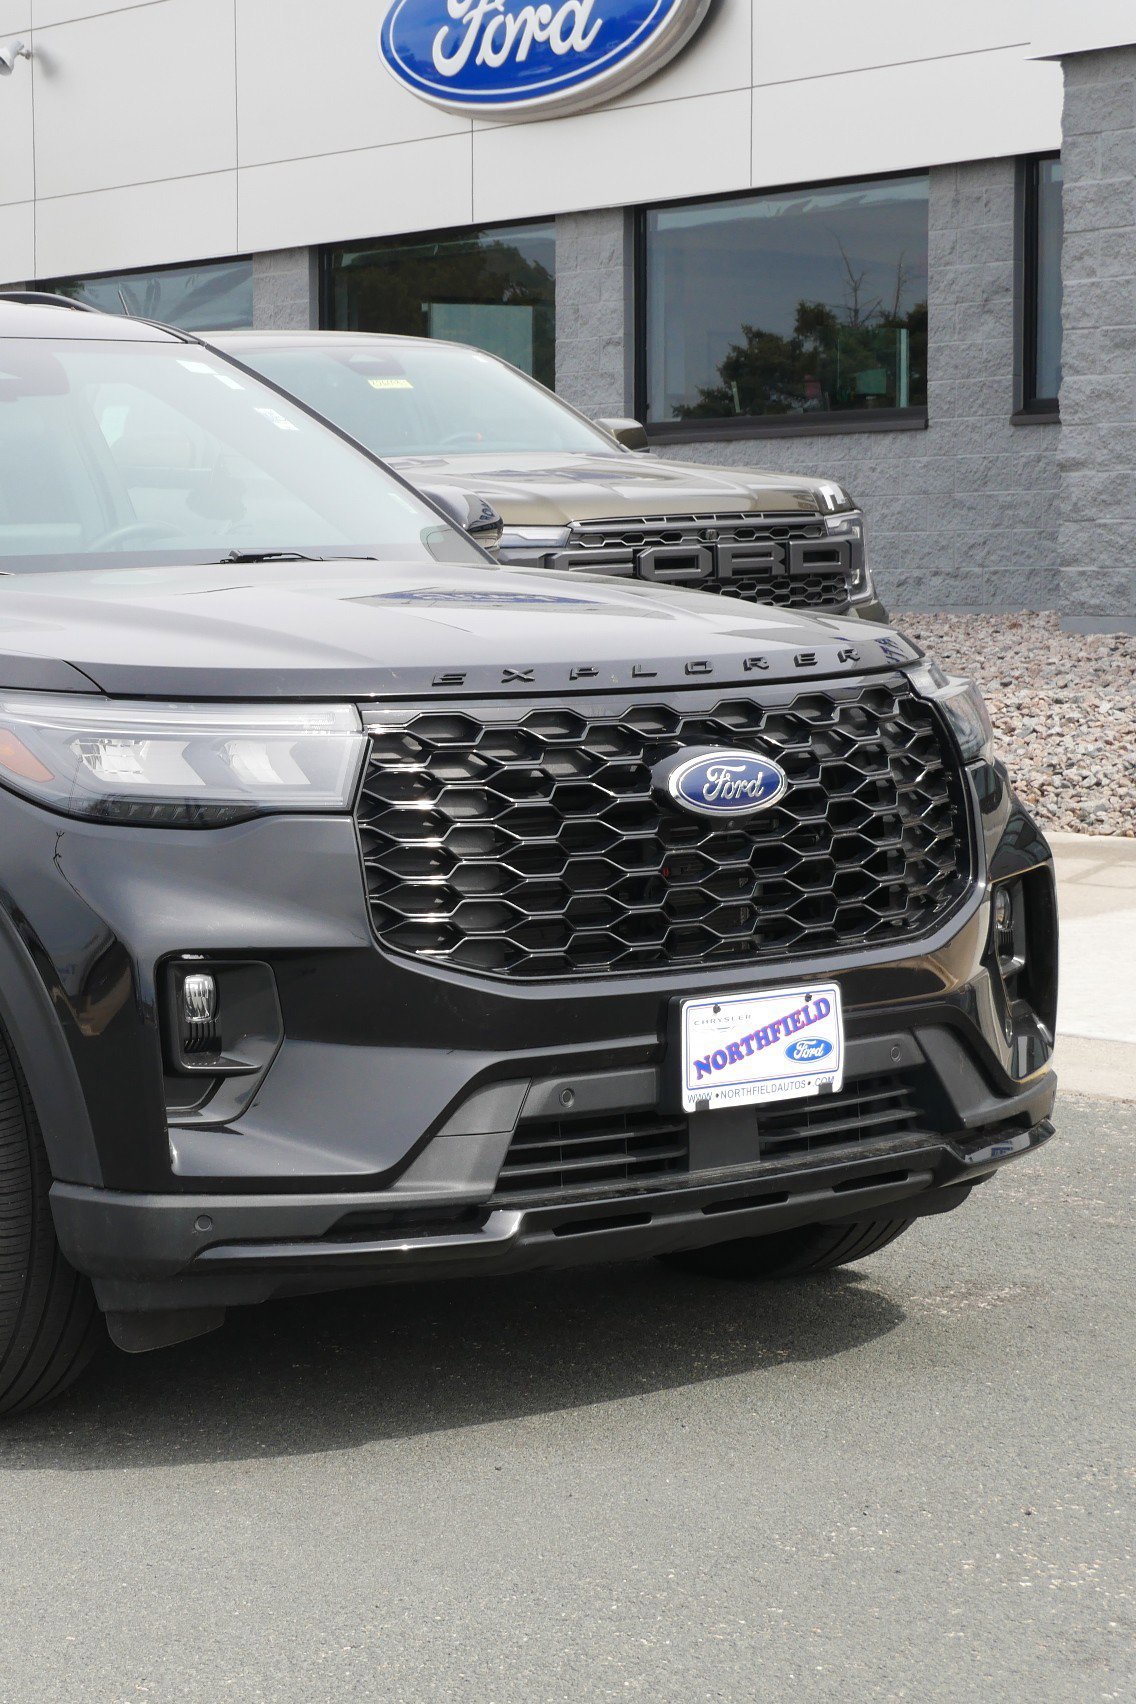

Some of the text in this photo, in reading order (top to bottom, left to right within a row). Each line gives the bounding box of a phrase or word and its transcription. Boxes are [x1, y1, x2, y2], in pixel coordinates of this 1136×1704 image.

[431, 0, 603, 77] Ford
[552, 540, 853, 583] FORD
[431, 647, 862, 687] EXPLORER
[702, 764, 765, 802] Ford
[692, 997, 832, 1081] NORTHFIELD
[693, 1014, 752, 1026] CHRYSLER
[793, 1040, 824, 1060] Ford
